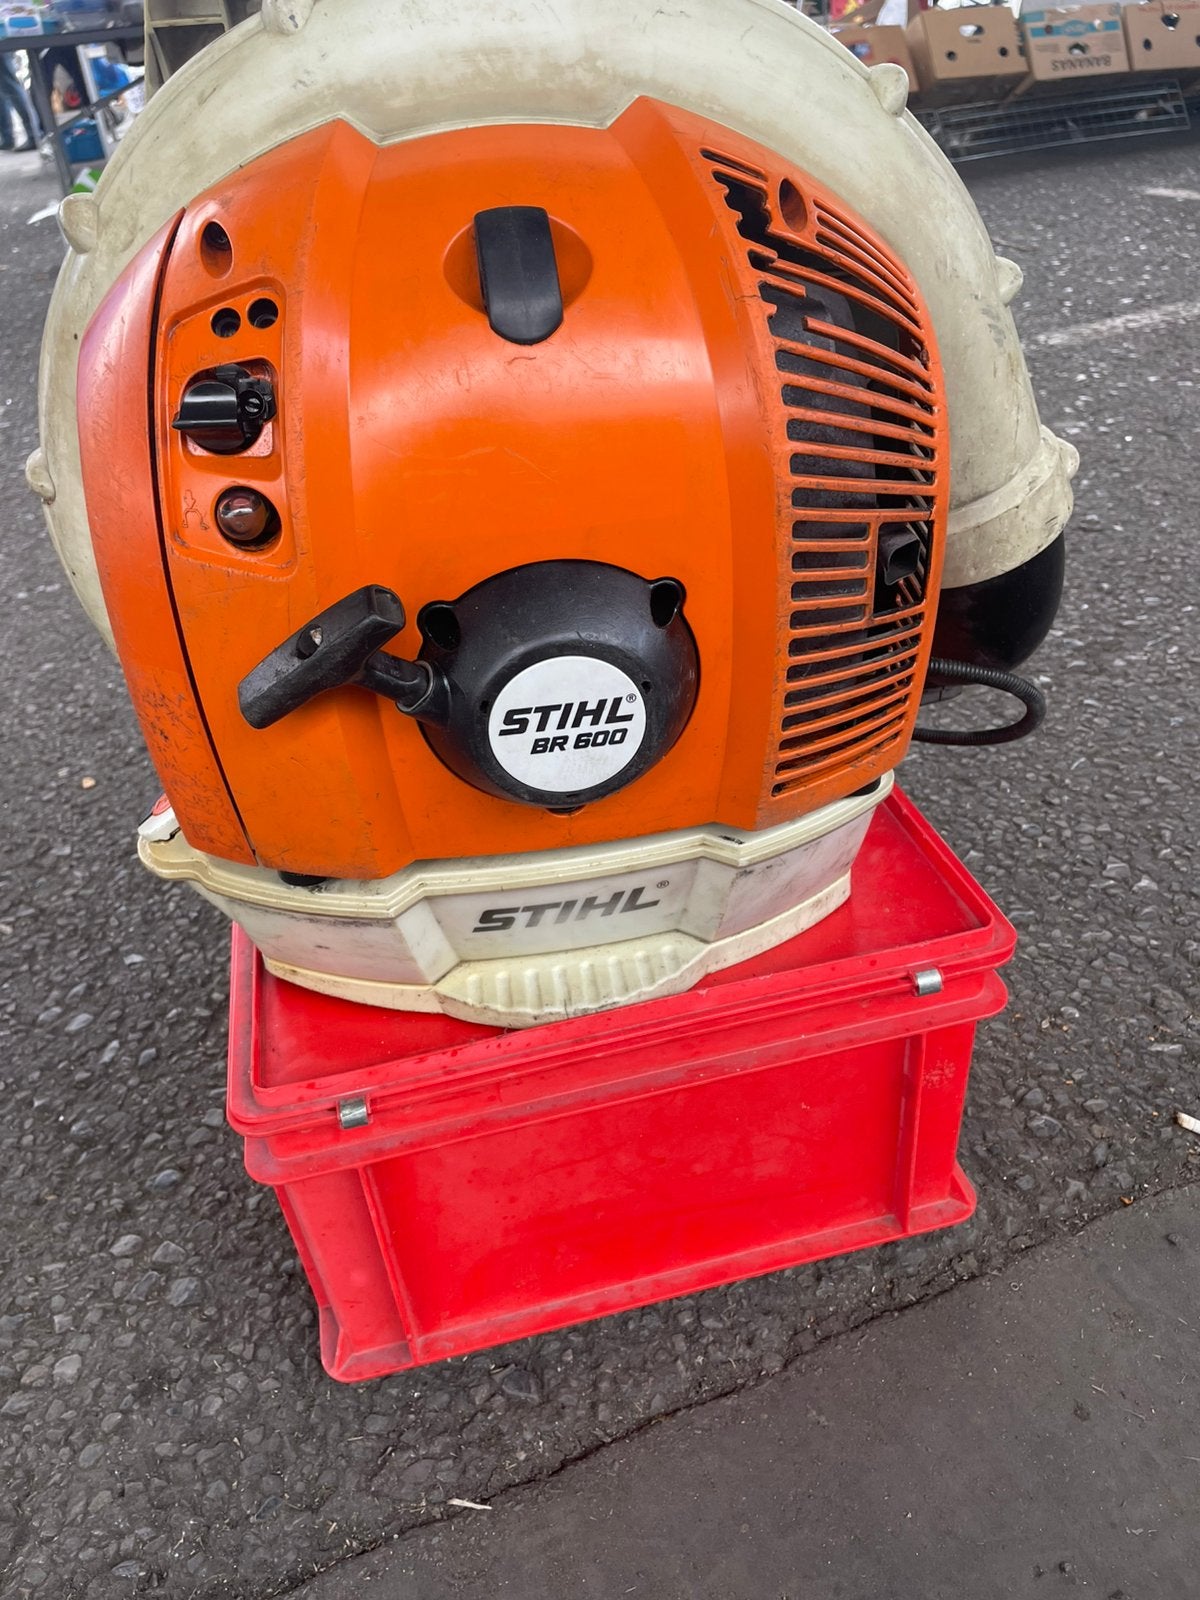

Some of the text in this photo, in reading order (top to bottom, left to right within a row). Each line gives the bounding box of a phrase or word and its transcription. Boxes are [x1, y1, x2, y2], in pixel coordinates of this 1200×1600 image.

[1051, 54, 1112, 72] BANANAS
[530, 728, 628, 755] BR 600
